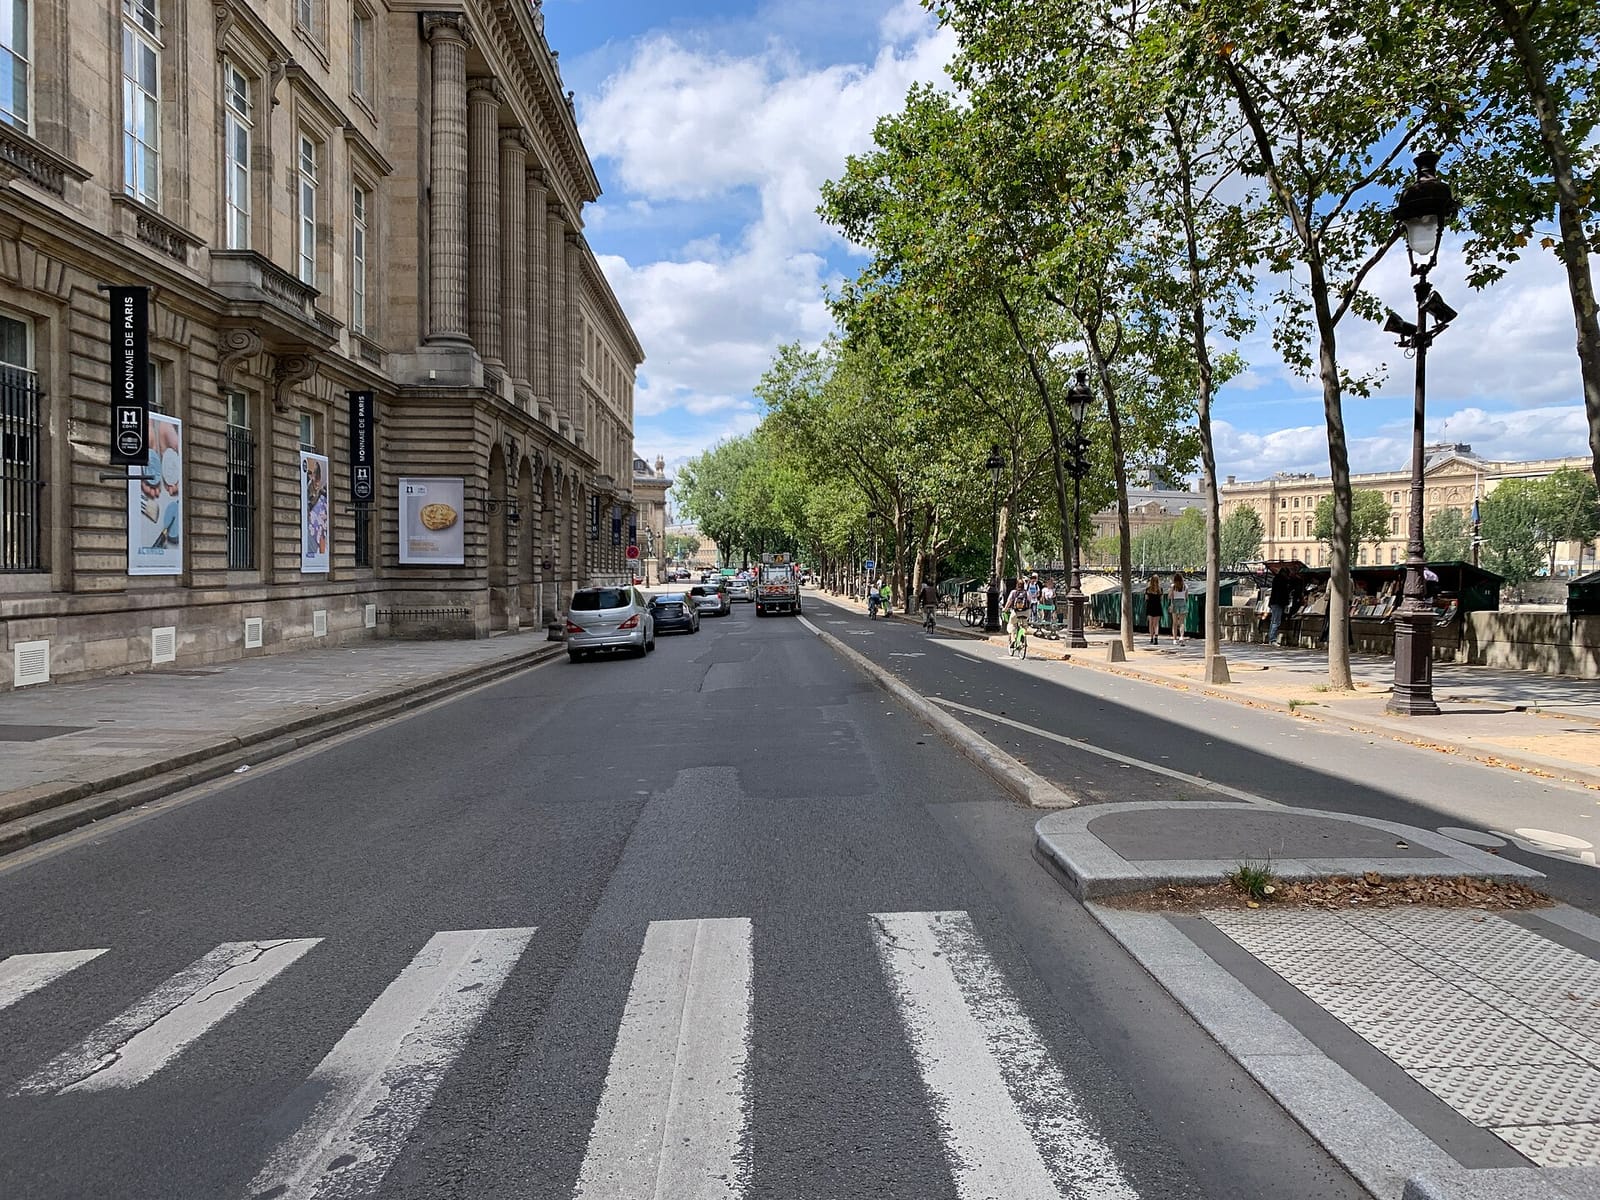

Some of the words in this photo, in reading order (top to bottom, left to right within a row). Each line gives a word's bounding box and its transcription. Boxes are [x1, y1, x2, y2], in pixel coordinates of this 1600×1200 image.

[124, 296, 134, 328] PARIS
[124, 332, 134, 346] DE
[124, 350, 134, 398] MONNAIE
[359, 418, 365, 428] DE
